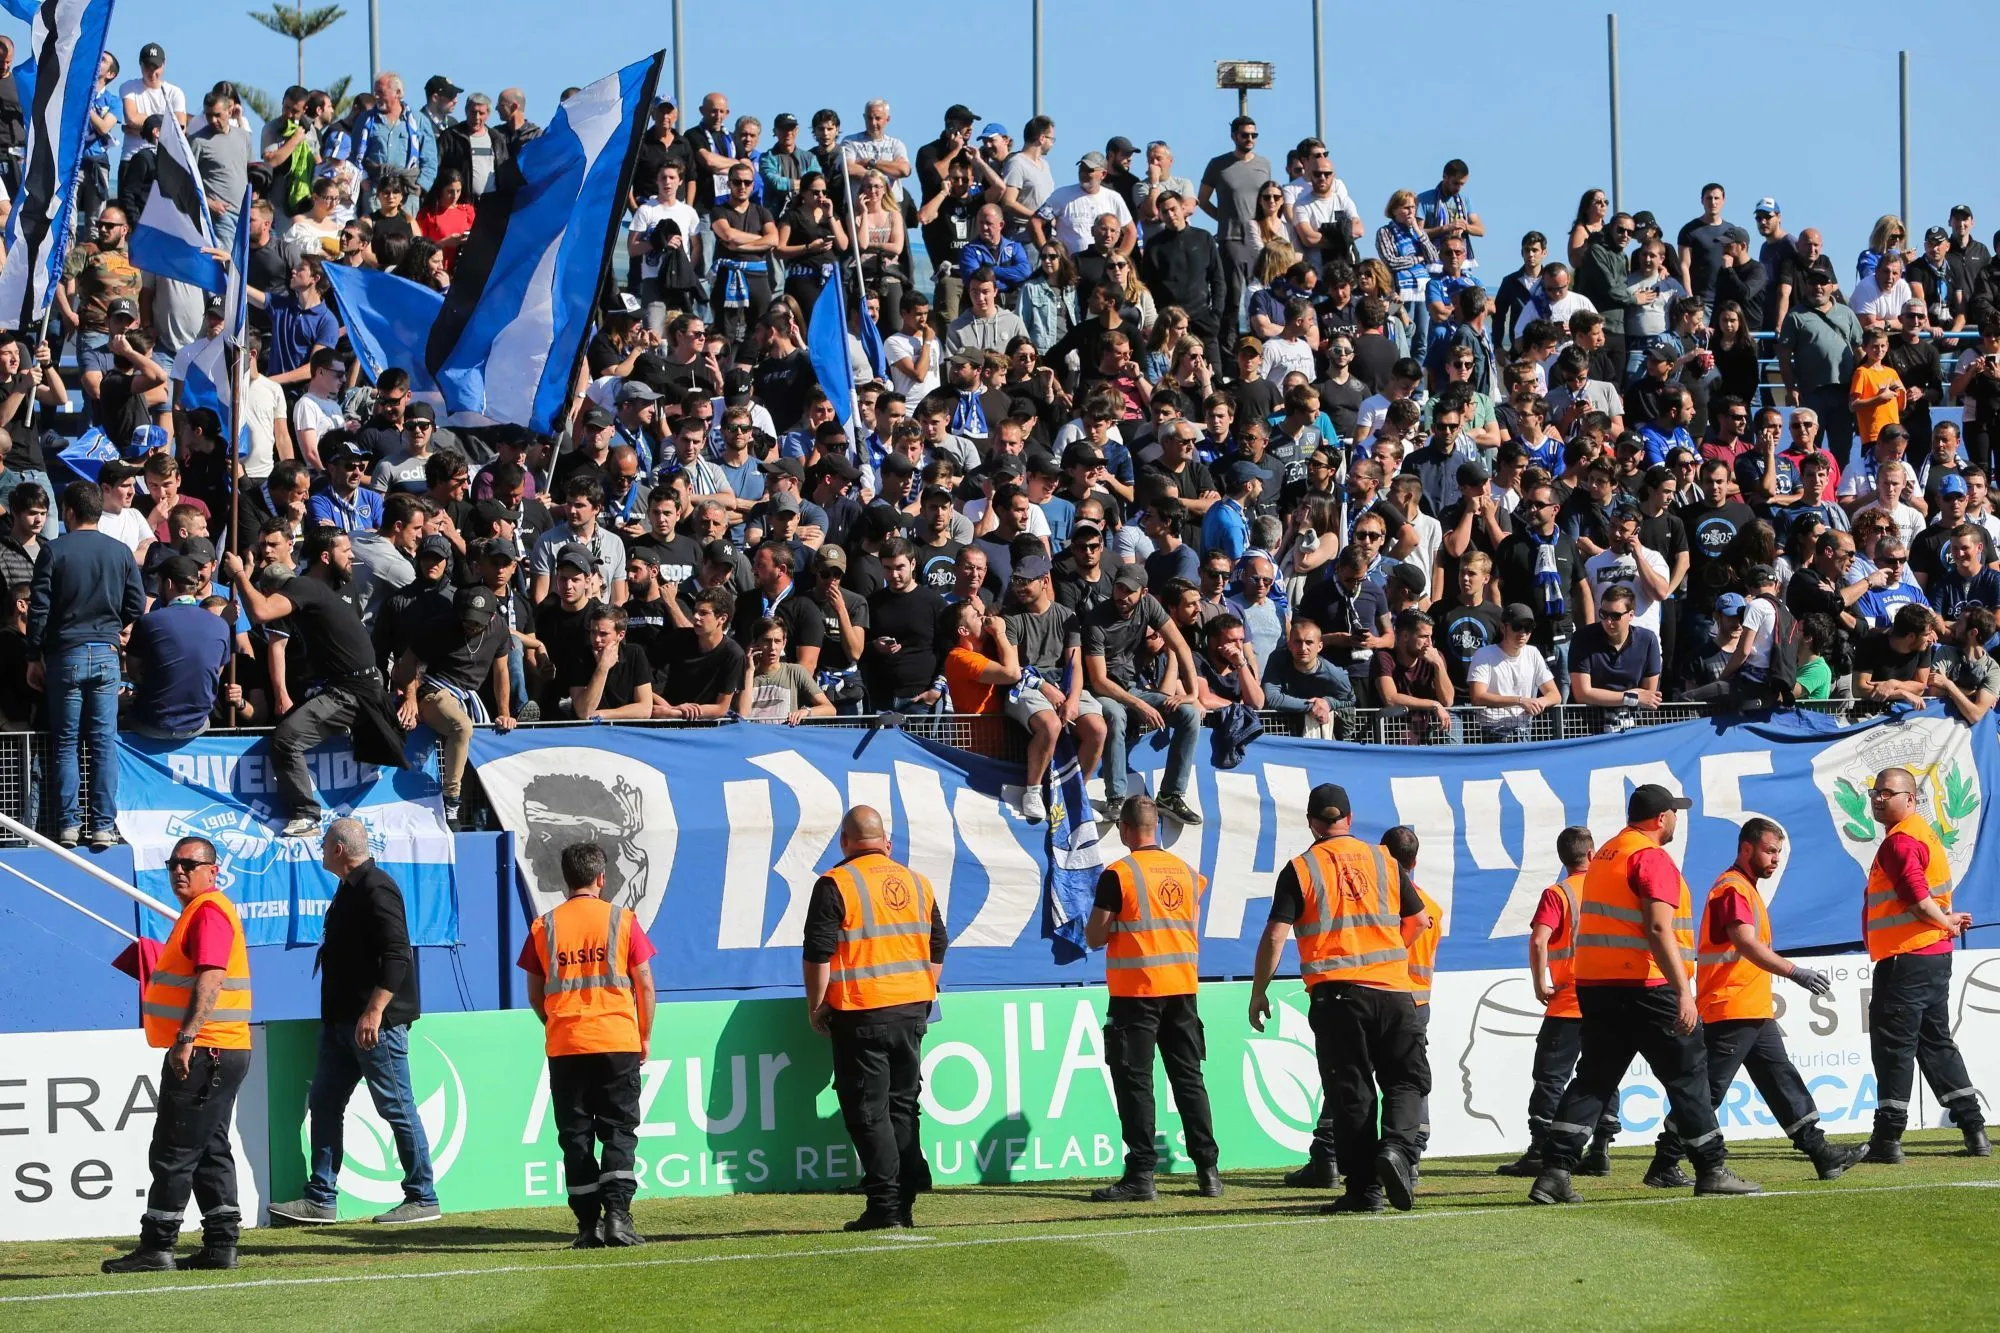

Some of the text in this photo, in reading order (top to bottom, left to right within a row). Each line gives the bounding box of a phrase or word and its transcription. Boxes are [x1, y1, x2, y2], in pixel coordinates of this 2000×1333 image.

[1700, 532, 1733, 545] 1905
[928, 571, 957, 585] 1905
[168, 751, 382, 793] RIVESIDE
[201, 811, 237, 830] 1909
[1790, 1049, 1861, 1068] turiale
[1619, 1074, 1878, 1133] CRSCA
[525, 1130, 1193, 1197] ERGIES REUVELABES
